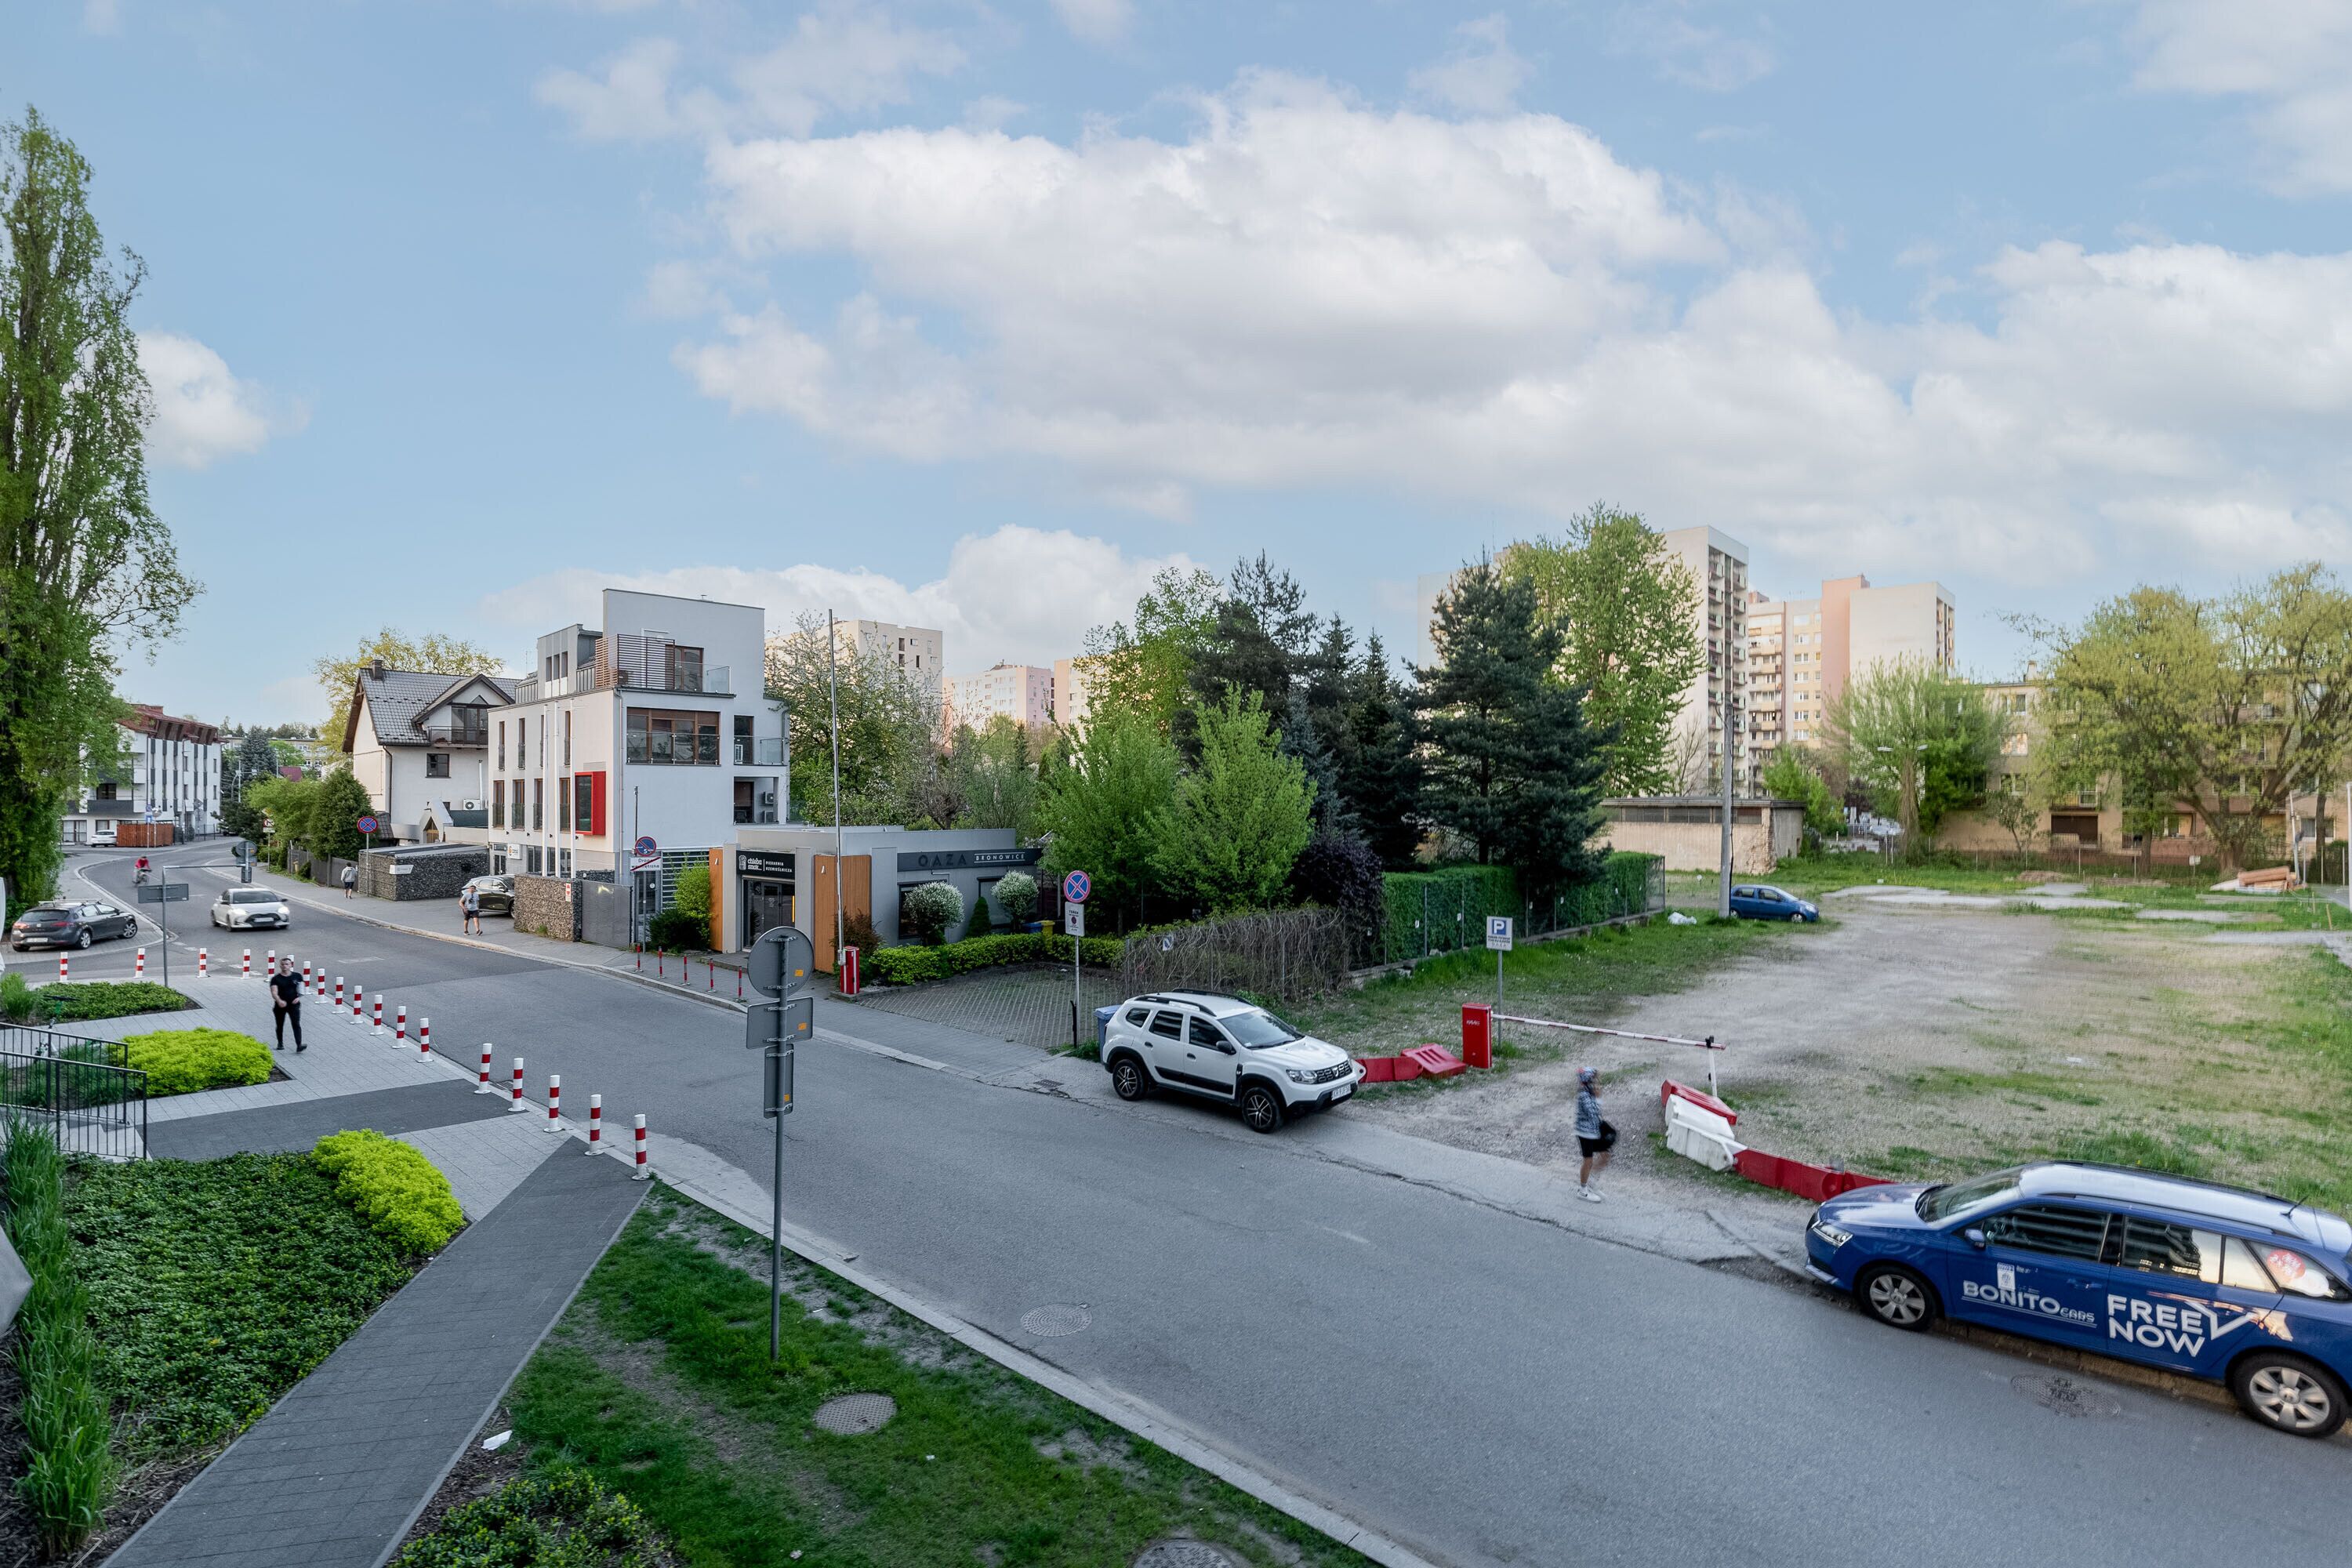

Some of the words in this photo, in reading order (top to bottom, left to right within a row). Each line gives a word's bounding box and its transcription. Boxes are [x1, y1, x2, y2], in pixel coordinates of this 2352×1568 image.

[918, 854, 967, 867] OAZA
[1494, 920, 1505, 934] P
[1963, 1279, 2060, 1314] BONITO
[2060, 1307, 2096, 1323] CARS
[2107, 1294, 2203, 1335] FREE
[2108, 1316, 2205, 1357] NOW
